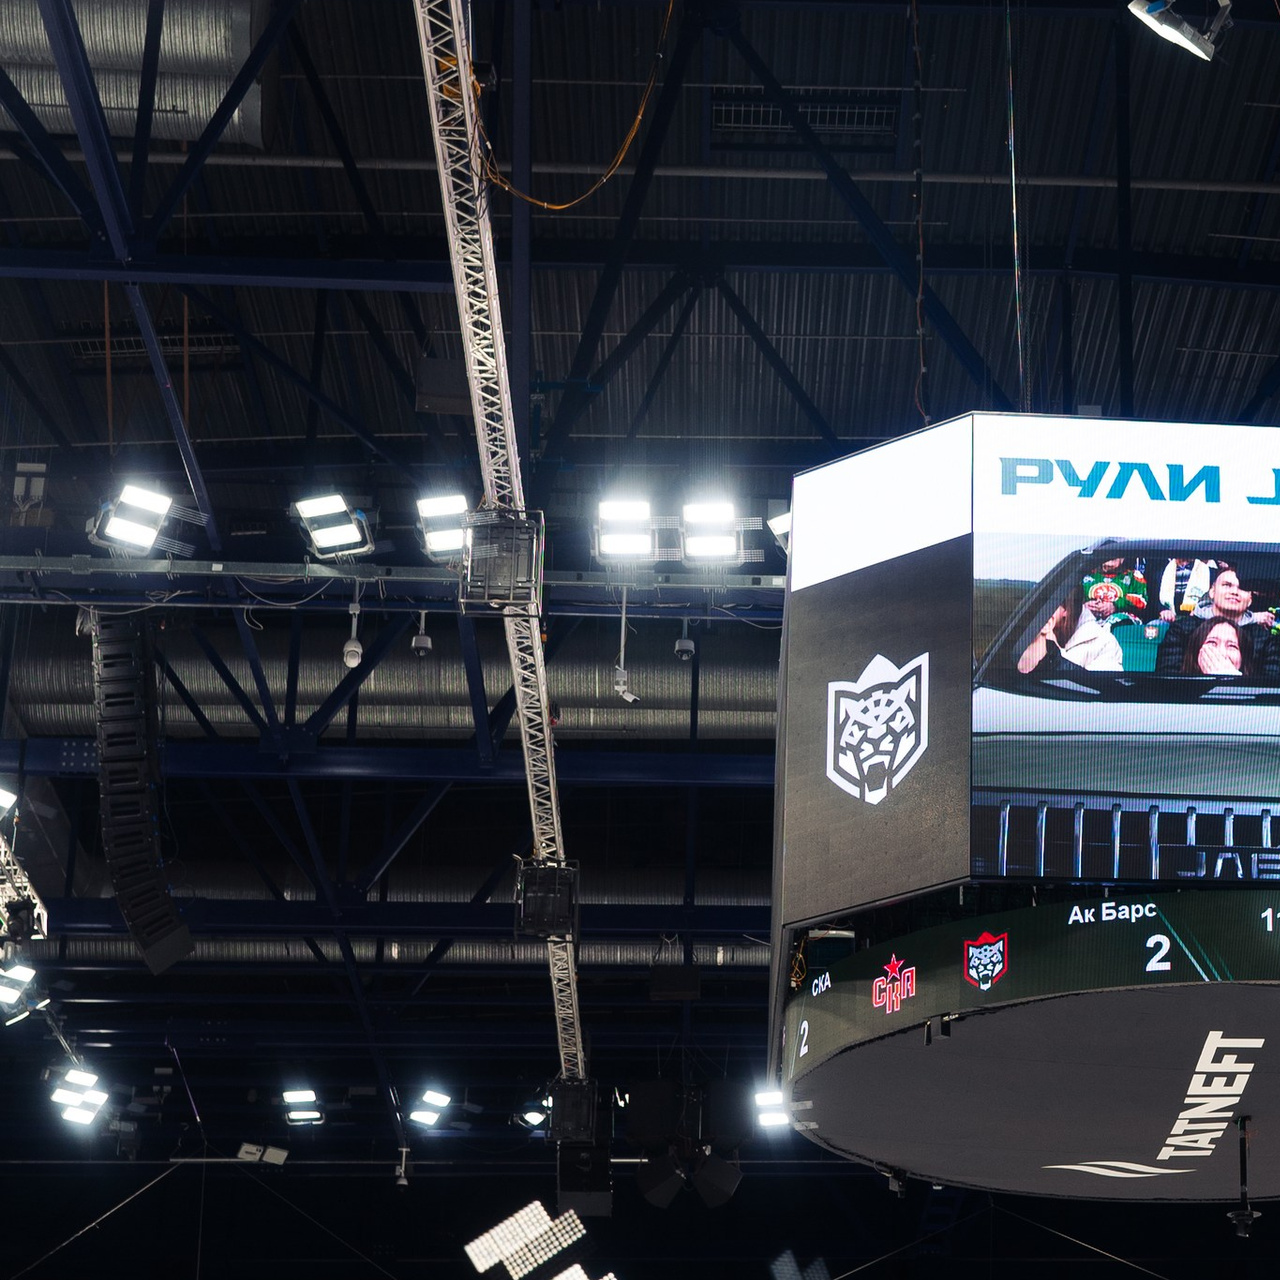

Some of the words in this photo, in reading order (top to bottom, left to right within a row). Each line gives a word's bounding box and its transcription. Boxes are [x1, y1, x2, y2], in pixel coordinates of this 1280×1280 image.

[999, 457, 1221, 503] РУЛИ
[1068, 906, 1095, 924] Ак
[1101, 902, 1157, 923] Барс
[1145, 934, 1172, 971] 2
[812, 972, 831, 997] СКА
[872, 967, 916, 1014] СКА
[800, 1020, 809, 1057] 2
[1156, 1031, 1265, 1160] TATNEFT
